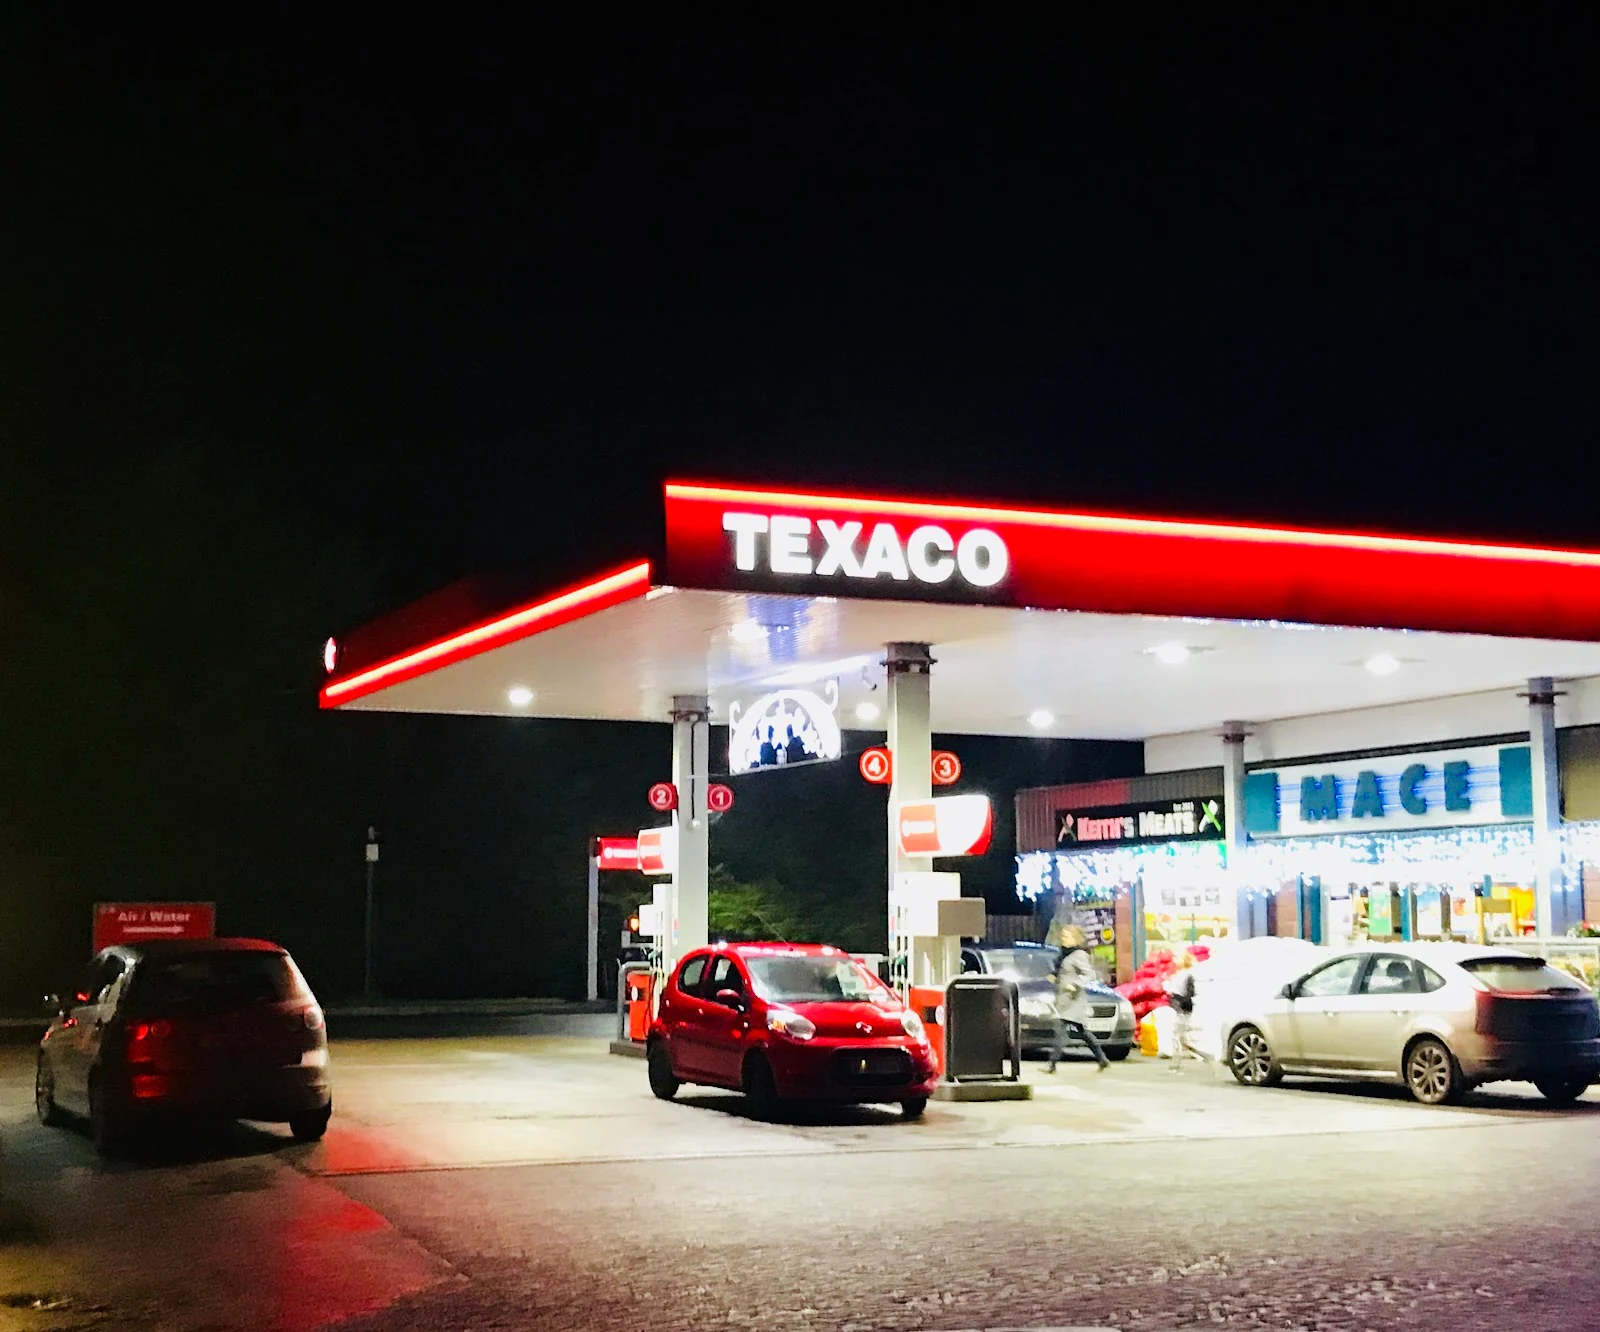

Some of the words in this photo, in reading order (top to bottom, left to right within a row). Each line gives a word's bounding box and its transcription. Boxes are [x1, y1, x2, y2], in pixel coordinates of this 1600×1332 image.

[722, 512, 1009, 587] TEXACO
[868, 756, 882, 775] 4
[939, 759, 952, 777] 3
[656, 789, 667, 804] 2
[715, 791, 725, 806] 1
[1299, 760, 1473, 822] MACE
[1138, 810, 1195, 837] MEATS
[117, 911, 138, 921] Air
[149, 910, 191, 922] Water
